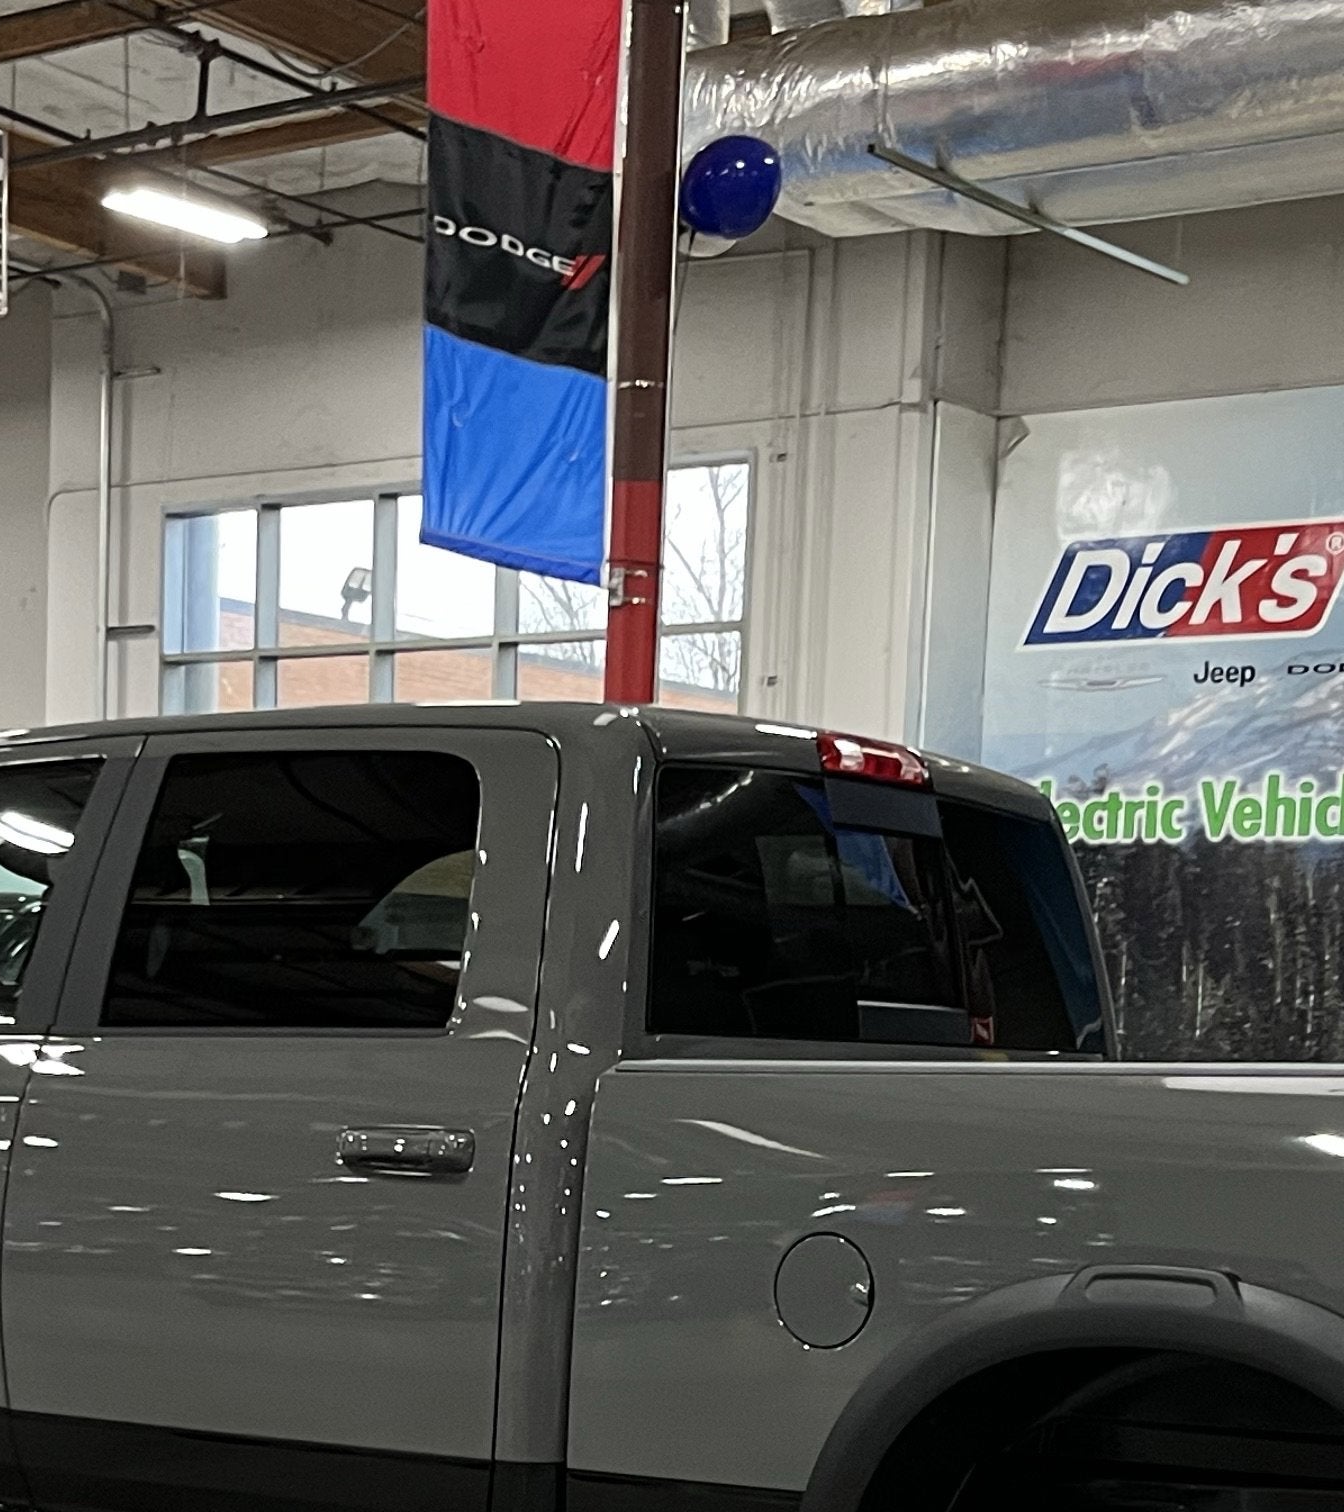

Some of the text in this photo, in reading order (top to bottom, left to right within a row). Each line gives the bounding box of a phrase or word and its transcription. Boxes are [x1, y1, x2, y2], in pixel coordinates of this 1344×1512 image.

[433, 215, 576, 277] DODGE
[1043, 532, 1328, 634] Dick's
[1193, 661, 1256, 687] Jeep
[1040, 780, 1185, 840] ectric
